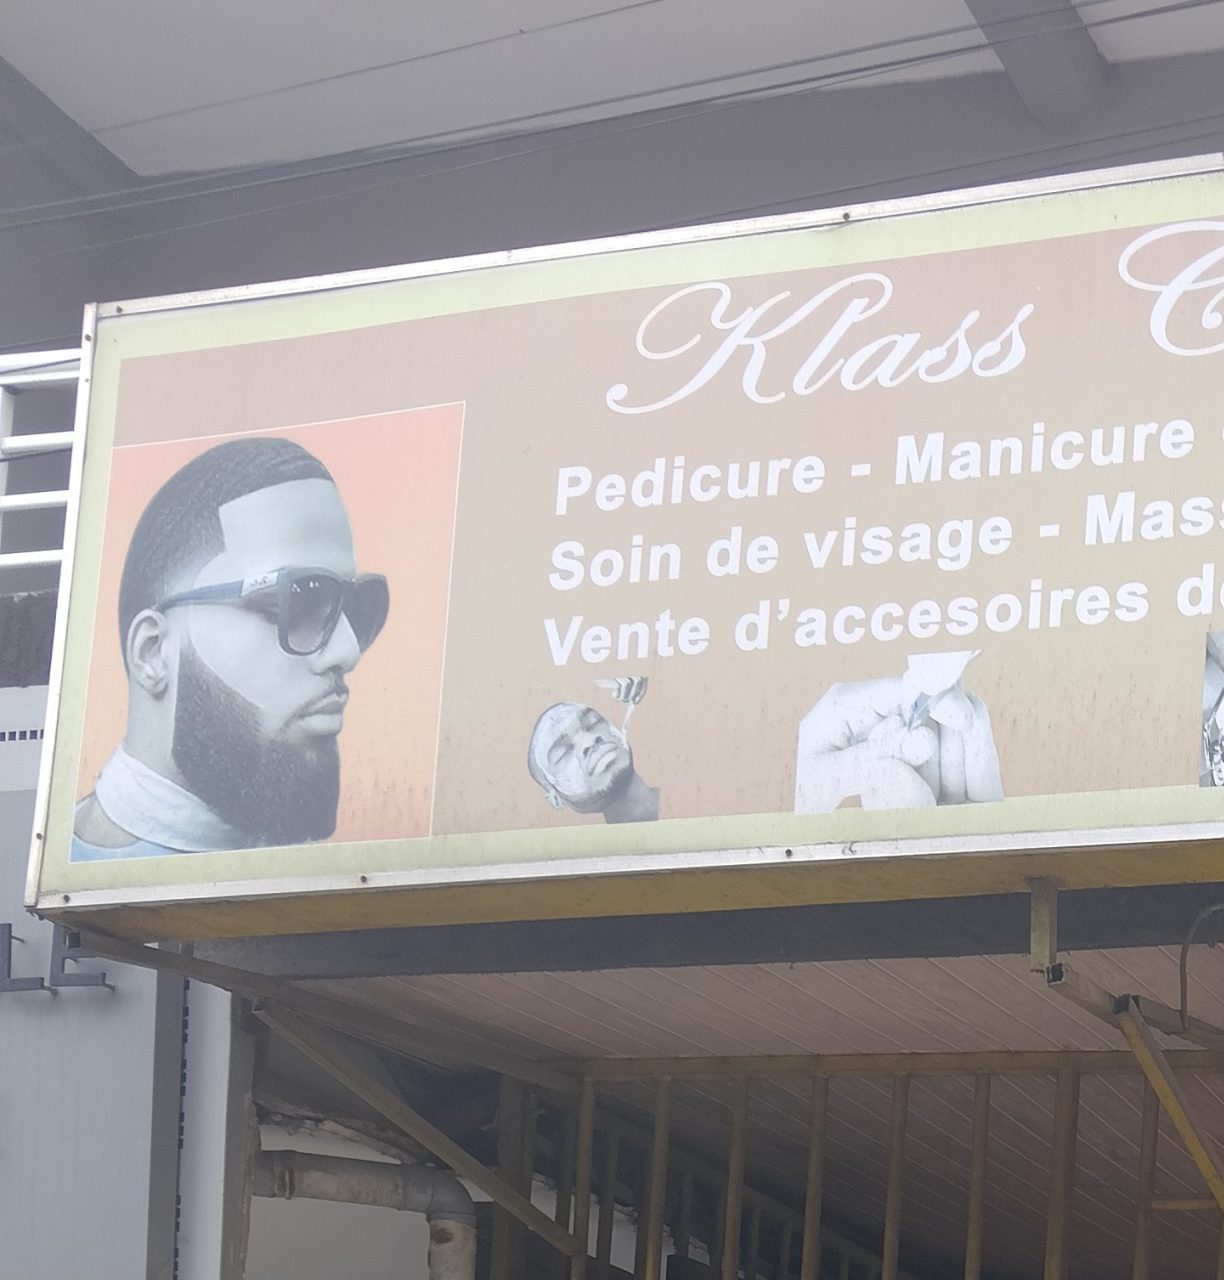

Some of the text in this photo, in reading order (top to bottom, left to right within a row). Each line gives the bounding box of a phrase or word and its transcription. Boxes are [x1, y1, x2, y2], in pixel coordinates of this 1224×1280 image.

[605, 272, 1035, 415] Klass
[555, 455, 825, 514] Pedicure
[894, 418, 1195, 486] Manicure
[548, 534, 681, 591] Soin
[706, 526, 779, 577] de
[802, 515, 1013, 572] visage
[543, 609, 711, 666] Vente
